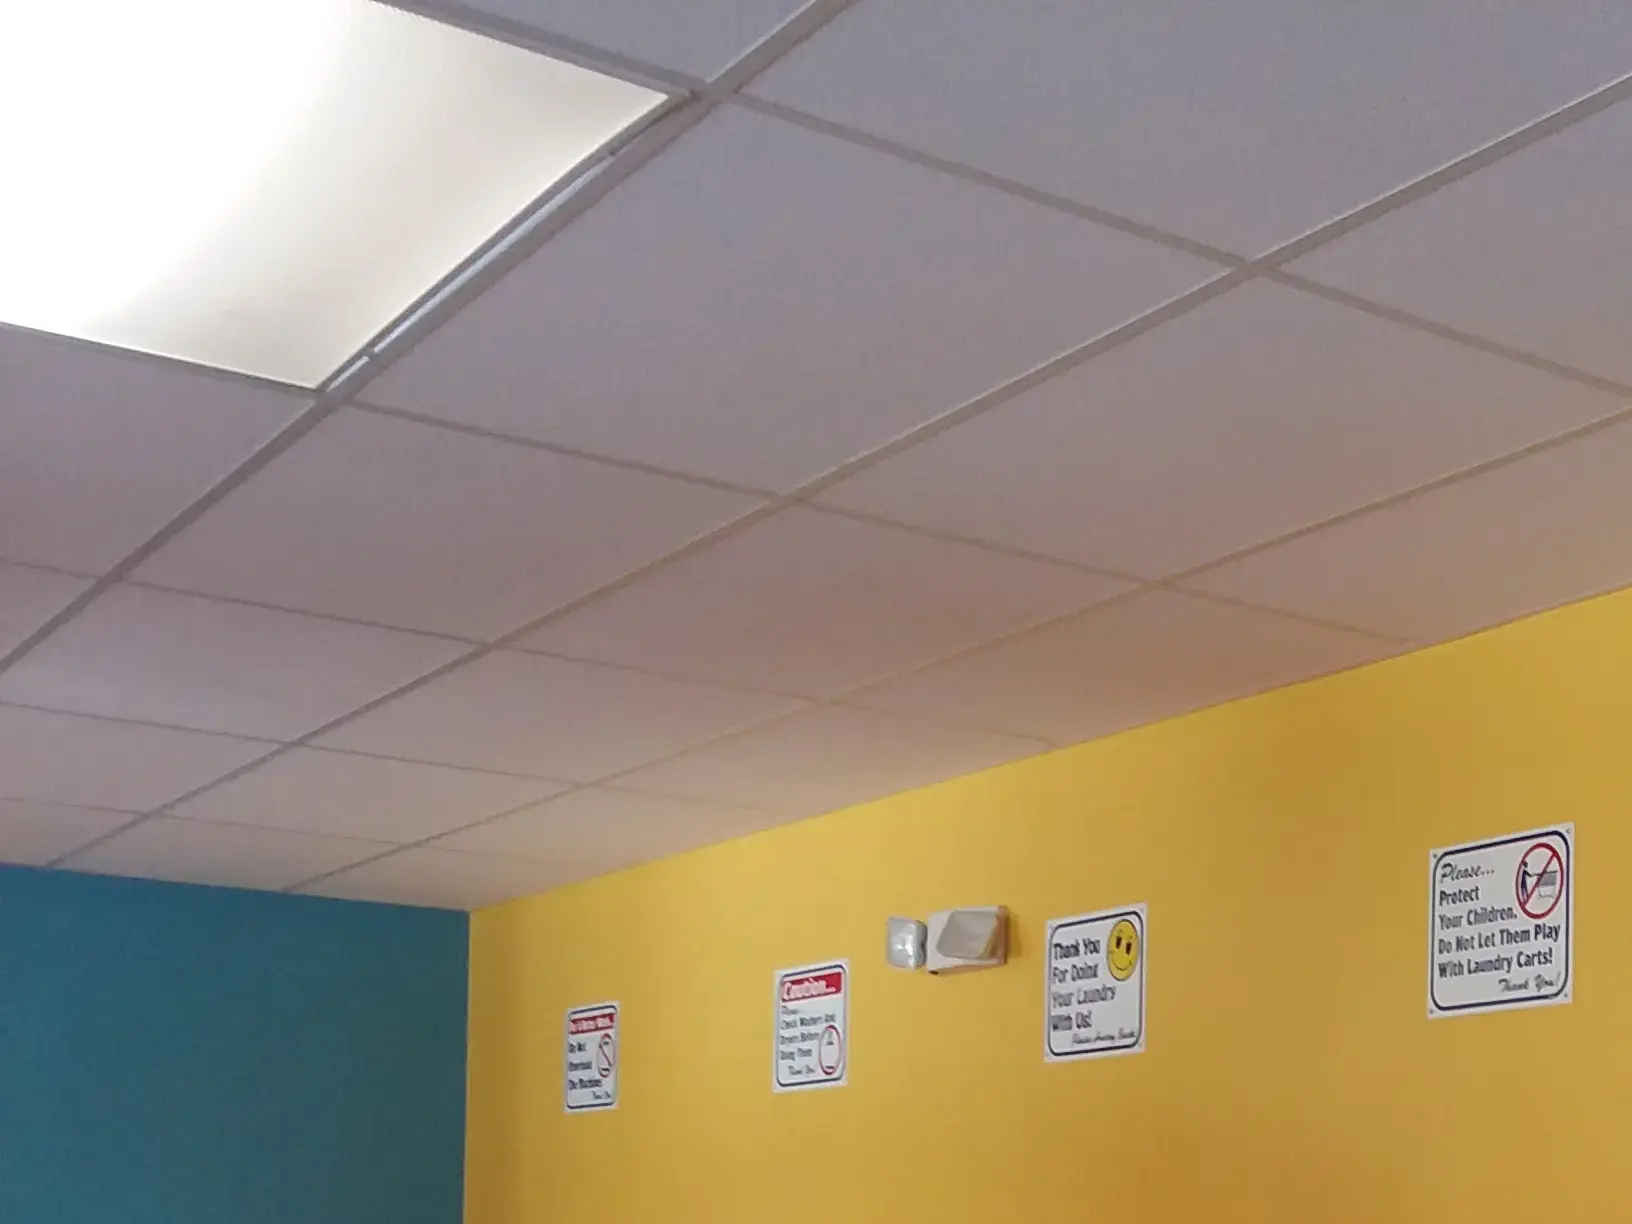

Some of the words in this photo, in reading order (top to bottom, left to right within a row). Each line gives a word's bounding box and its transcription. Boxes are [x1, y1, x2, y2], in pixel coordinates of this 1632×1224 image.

[1439, 886, 1480, 907] Protect
[1438, 913, 1464, 930] Your
[1054, 939, 1080, 960] Thank
[1082, 937, 1101, 956] You
[1438, 938, 1453, 955] Do
[1455, 935, 1475, 952] Not
[1478, 932, 1496, 949] Let
[1499, 927, 1531, 946] Them
[1534, 923, 1561, 943] Play
[1438, 961, 1464, 979] With
[1467, 954, 1513, 975] Laundry
[1516, 947, 1552, 968] Carts!
[1053, 967, 1069, 984] For
[1052, 991, 1074, 1008] Your
[1076, 984, 1117, 1005] Laundry
